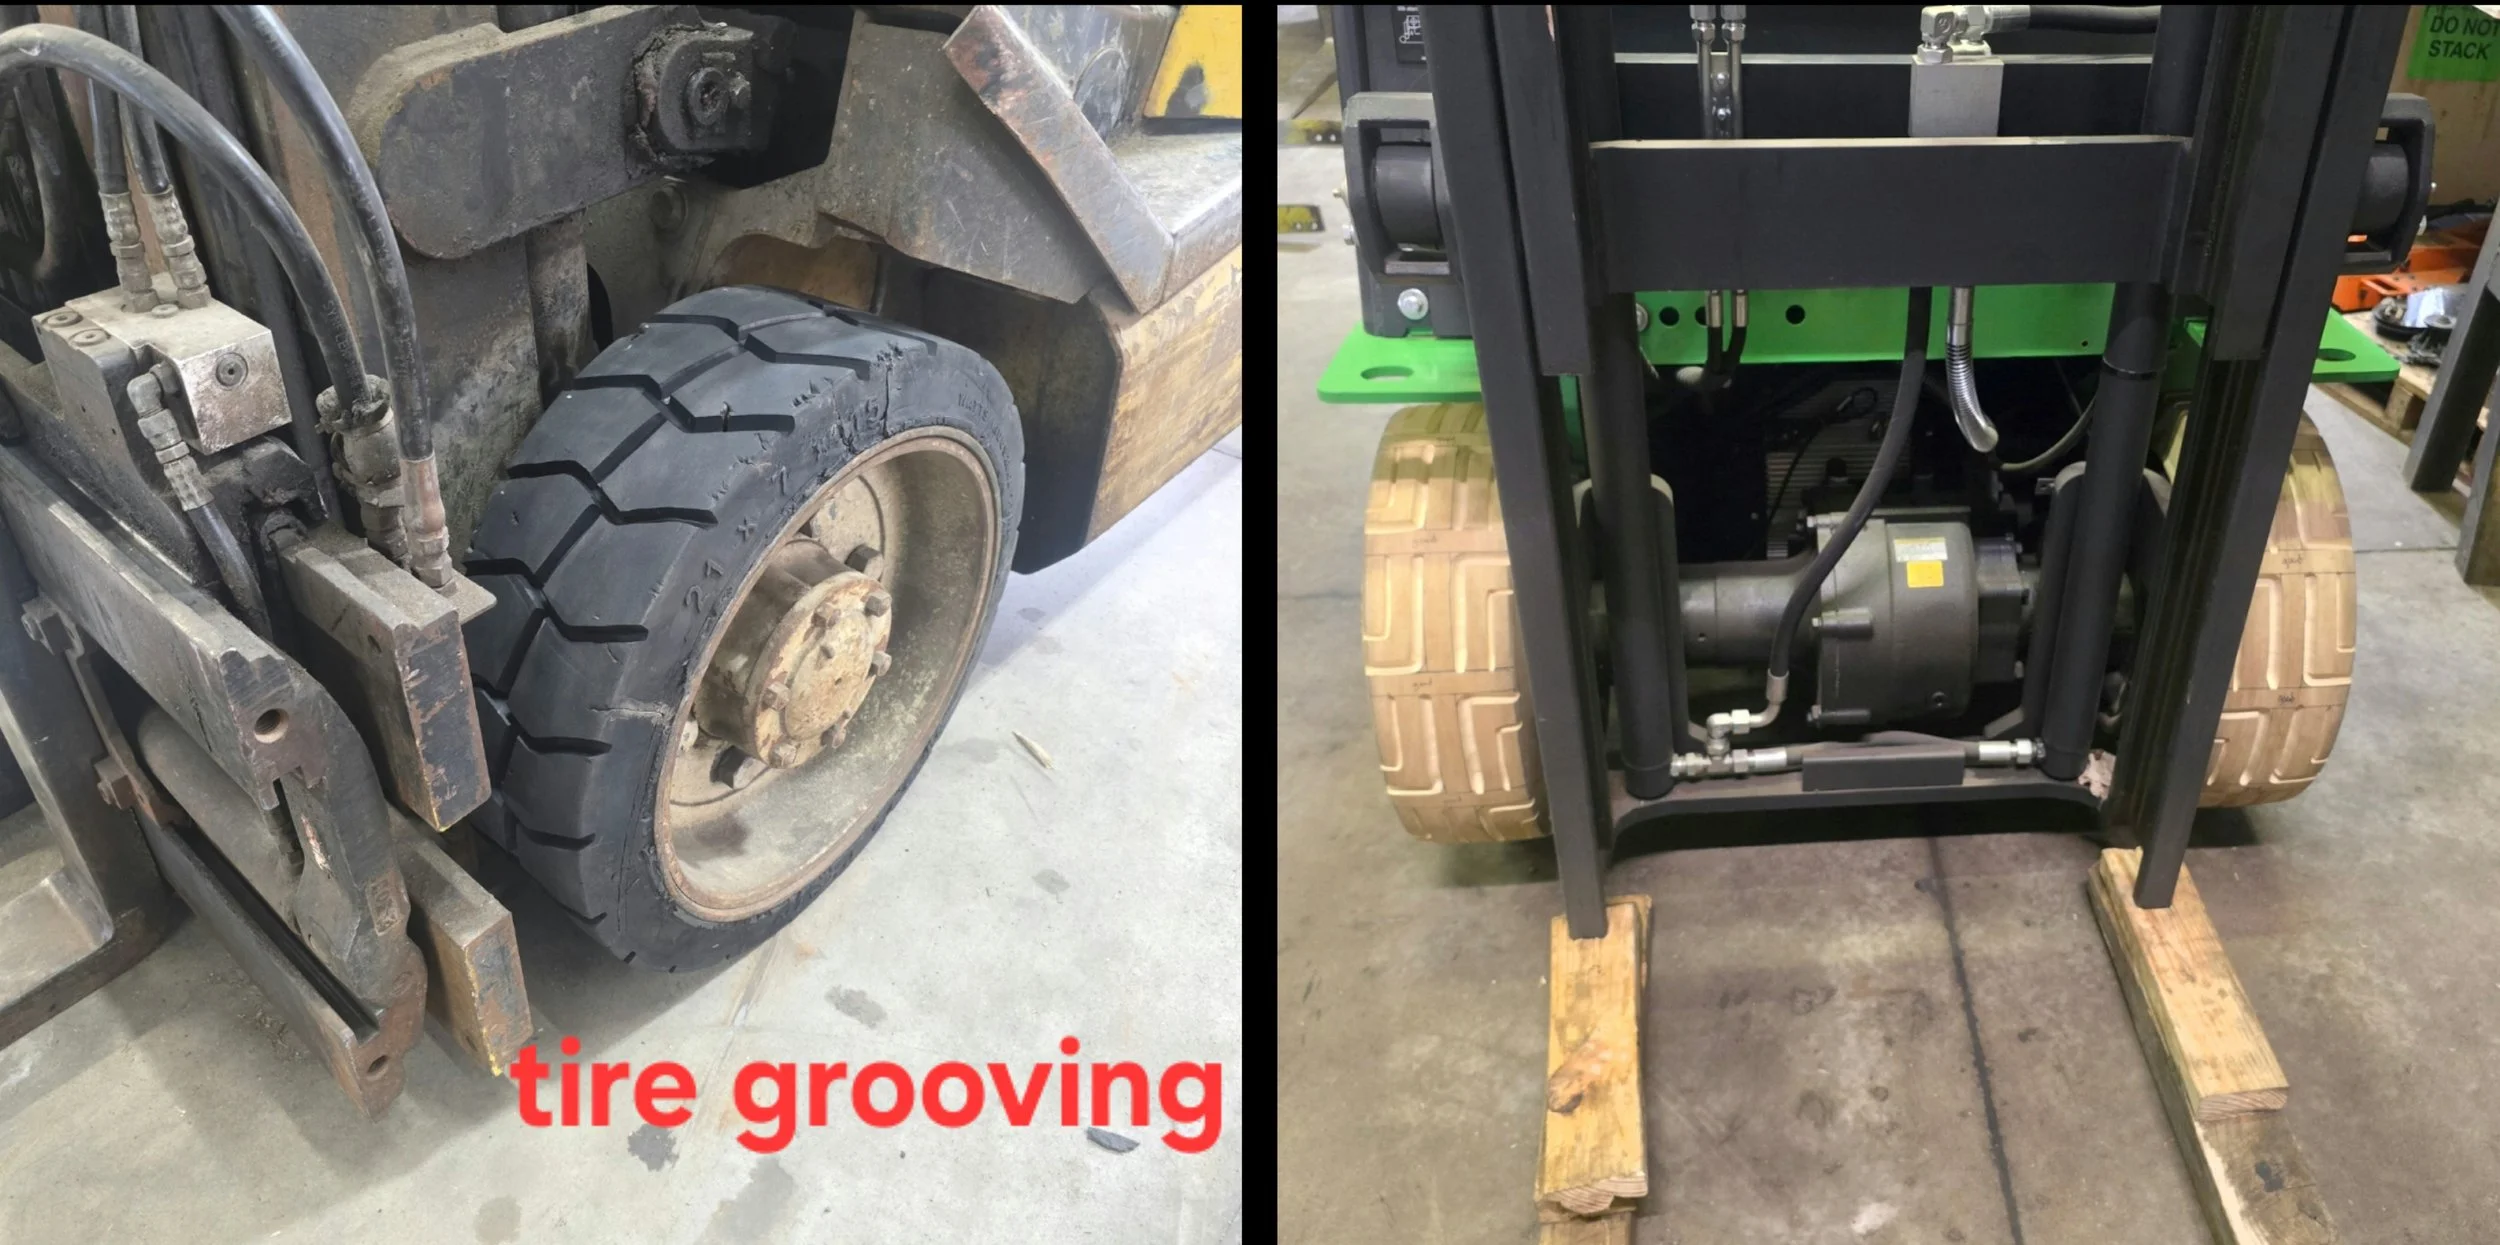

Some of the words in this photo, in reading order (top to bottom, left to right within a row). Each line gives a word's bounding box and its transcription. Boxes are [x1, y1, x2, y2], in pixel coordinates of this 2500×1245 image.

[2429, 15, 2459, 34] DO
[2462, 18, 2500, 37] NOT
[2428, 39, 2491, 60] STACK
[682, 557, 725, 614] 21
